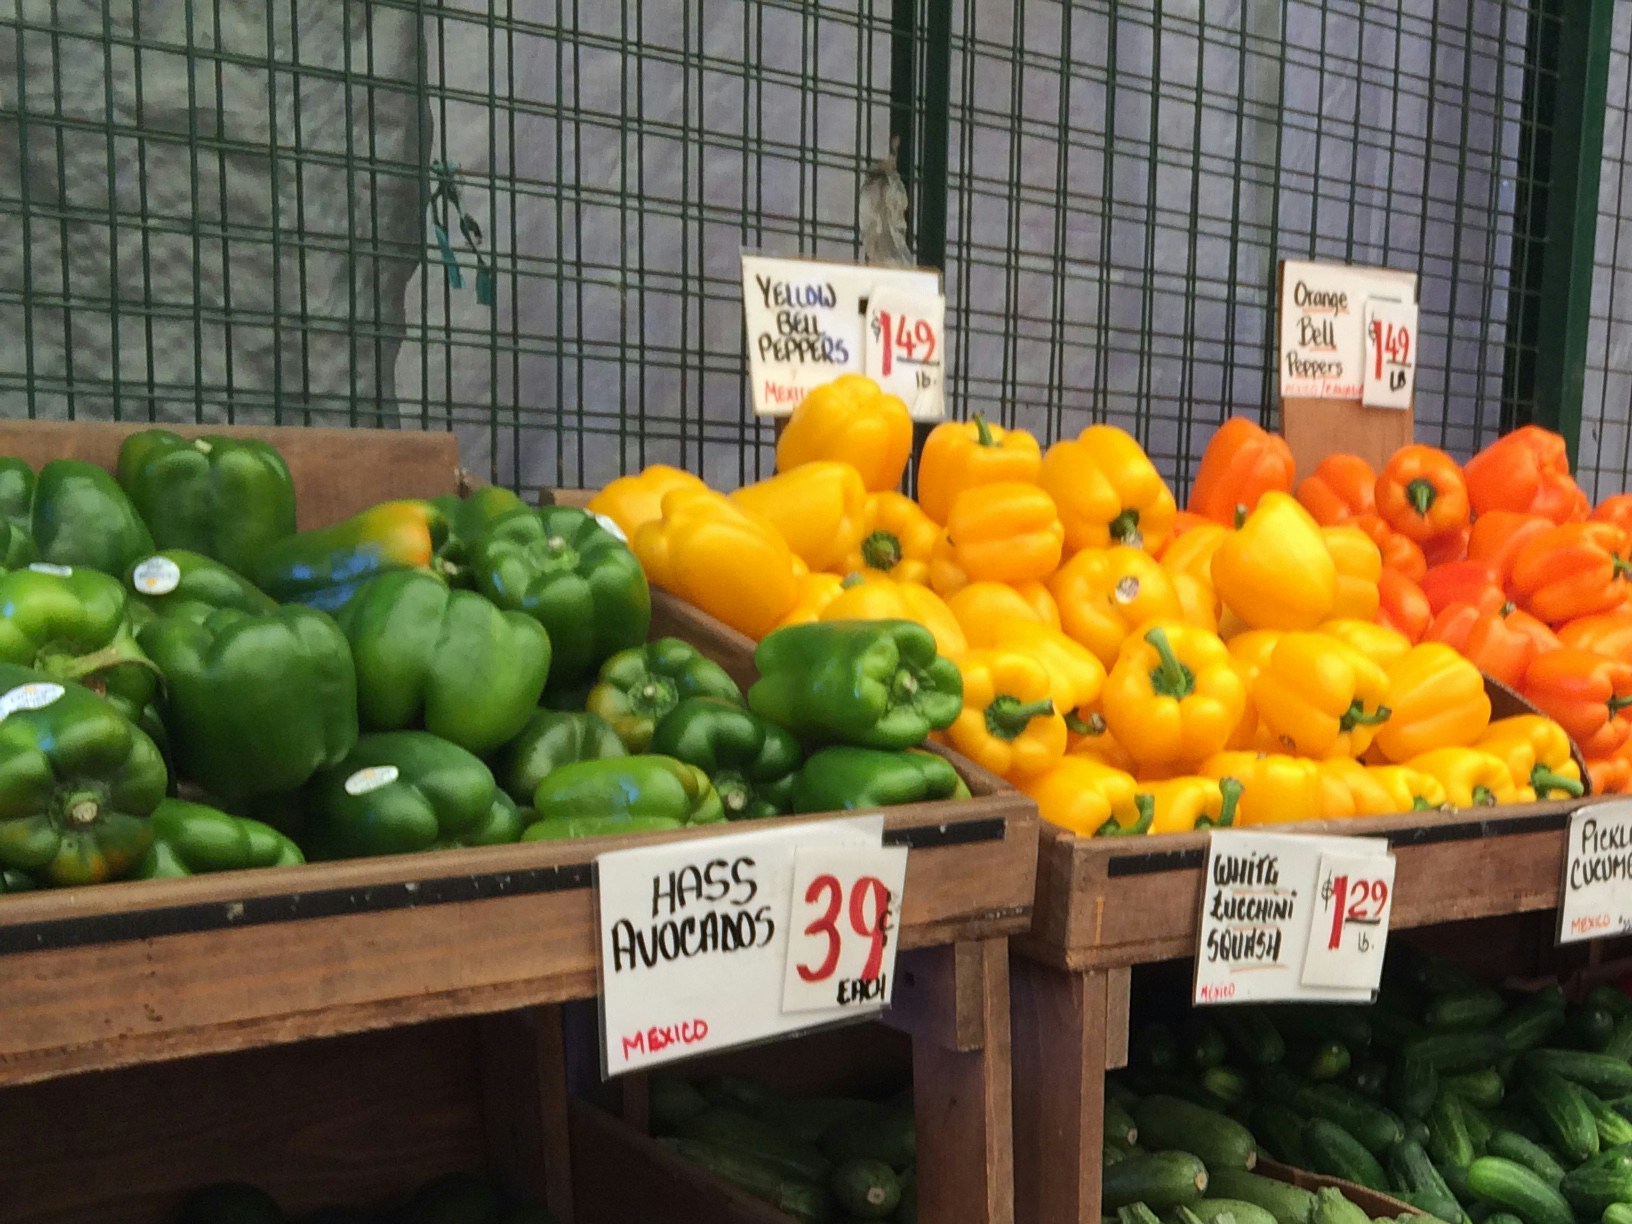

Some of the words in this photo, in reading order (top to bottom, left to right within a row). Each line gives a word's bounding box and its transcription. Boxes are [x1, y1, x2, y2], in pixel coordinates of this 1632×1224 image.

[756, 274, 837, 308] YELLOW
[1294, 280, 1348, 316] Orange
[776, 311, 819, 336] BELL
[1297, 316, 1337, 349] Bell
[758, 334, 849, 364] PEPPERS
[1286, 350, 1343, 379] Peppers
[1213, 852, 1279, 886] WHITE
[652, 857, 757, 918] HASS
[1210, 888, 1297, 923] ZUCCHINI
[611, 905, 775, 973] AVOCADOS
[1207, 926, 1282, 962] SQUASH
[836, 973, 886, 1005] EACH
[622, 1018, 709, 1060] MEXICO
